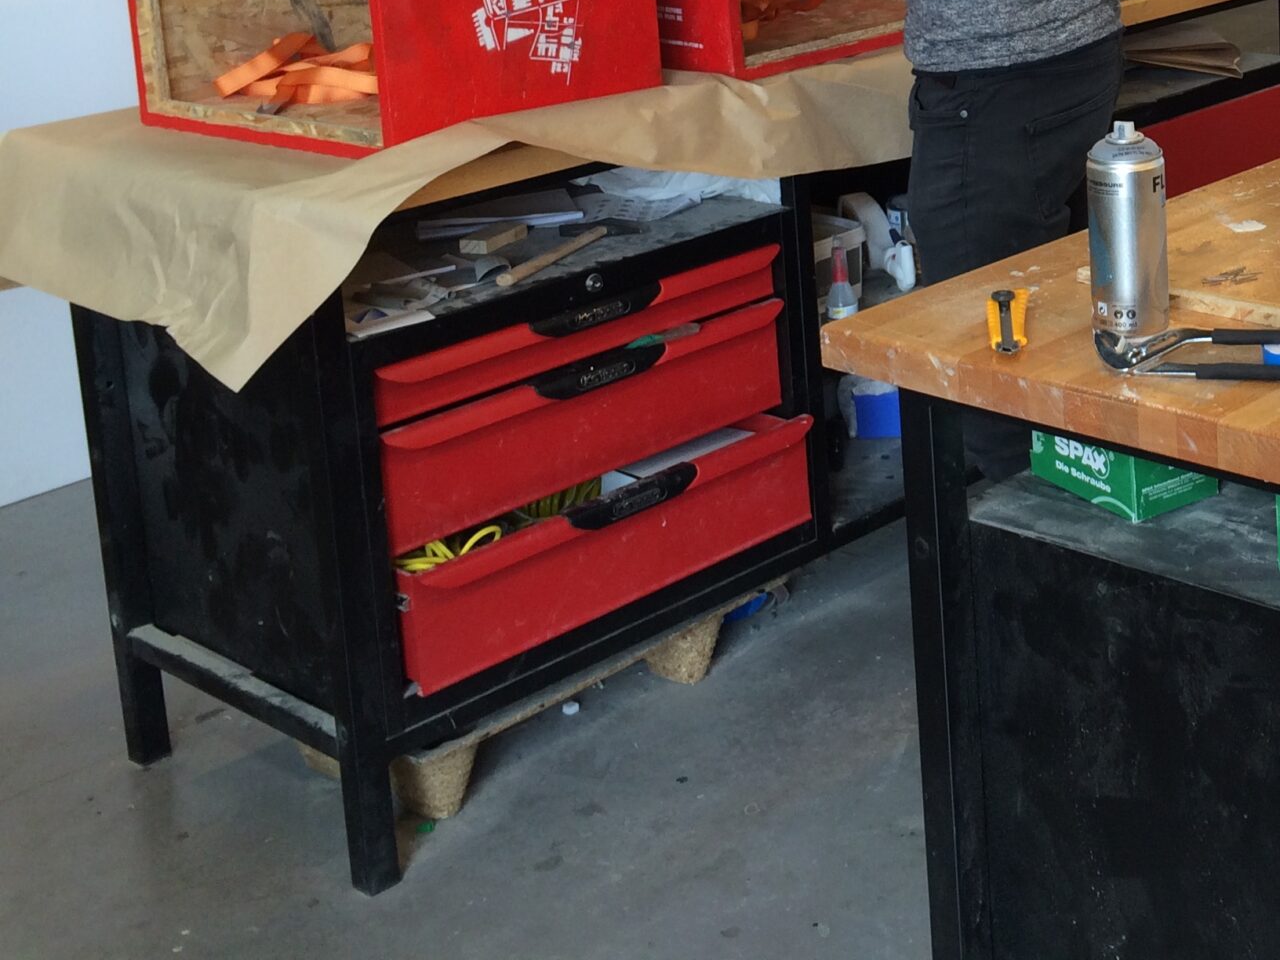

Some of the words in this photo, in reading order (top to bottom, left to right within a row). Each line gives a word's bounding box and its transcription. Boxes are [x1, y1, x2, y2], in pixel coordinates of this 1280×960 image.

[1055, 435, 1107, 474] SPAX
[1055, 460, 1070, 474] Die
[1071, 465, 1112, 493] Schraube
